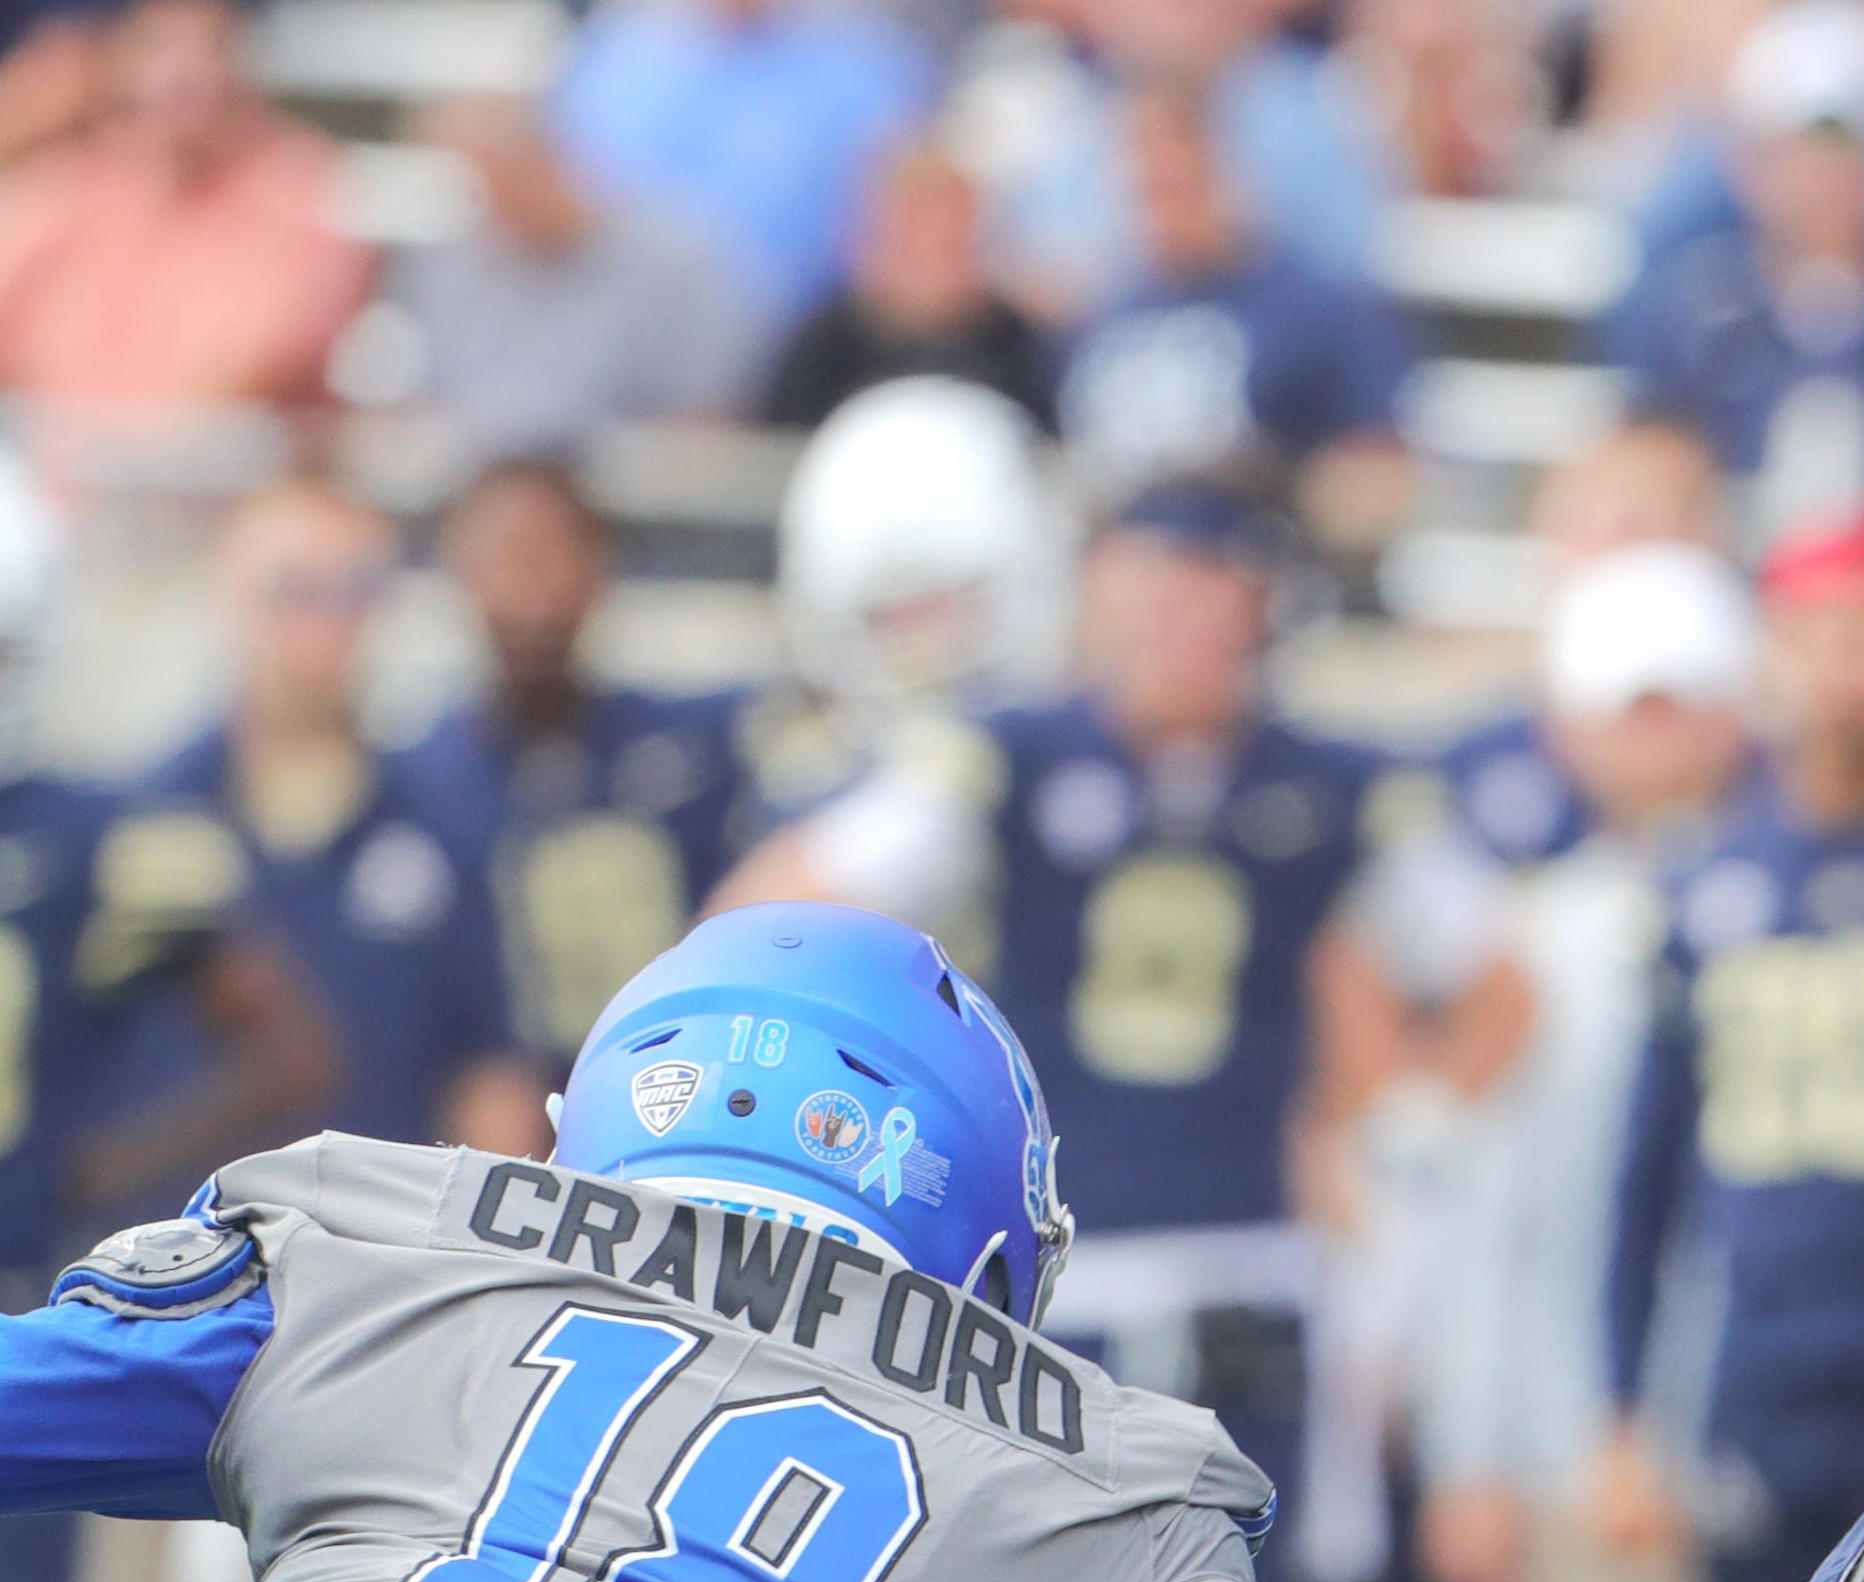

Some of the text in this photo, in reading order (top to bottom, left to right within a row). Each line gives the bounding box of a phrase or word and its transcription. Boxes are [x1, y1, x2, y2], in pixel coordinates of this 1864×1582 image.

[727, 1014, 790, 1068] 18
[637, 1081, 696, 1107] MAC
[468, 1160, 1085, 1456] CRAWFORD
